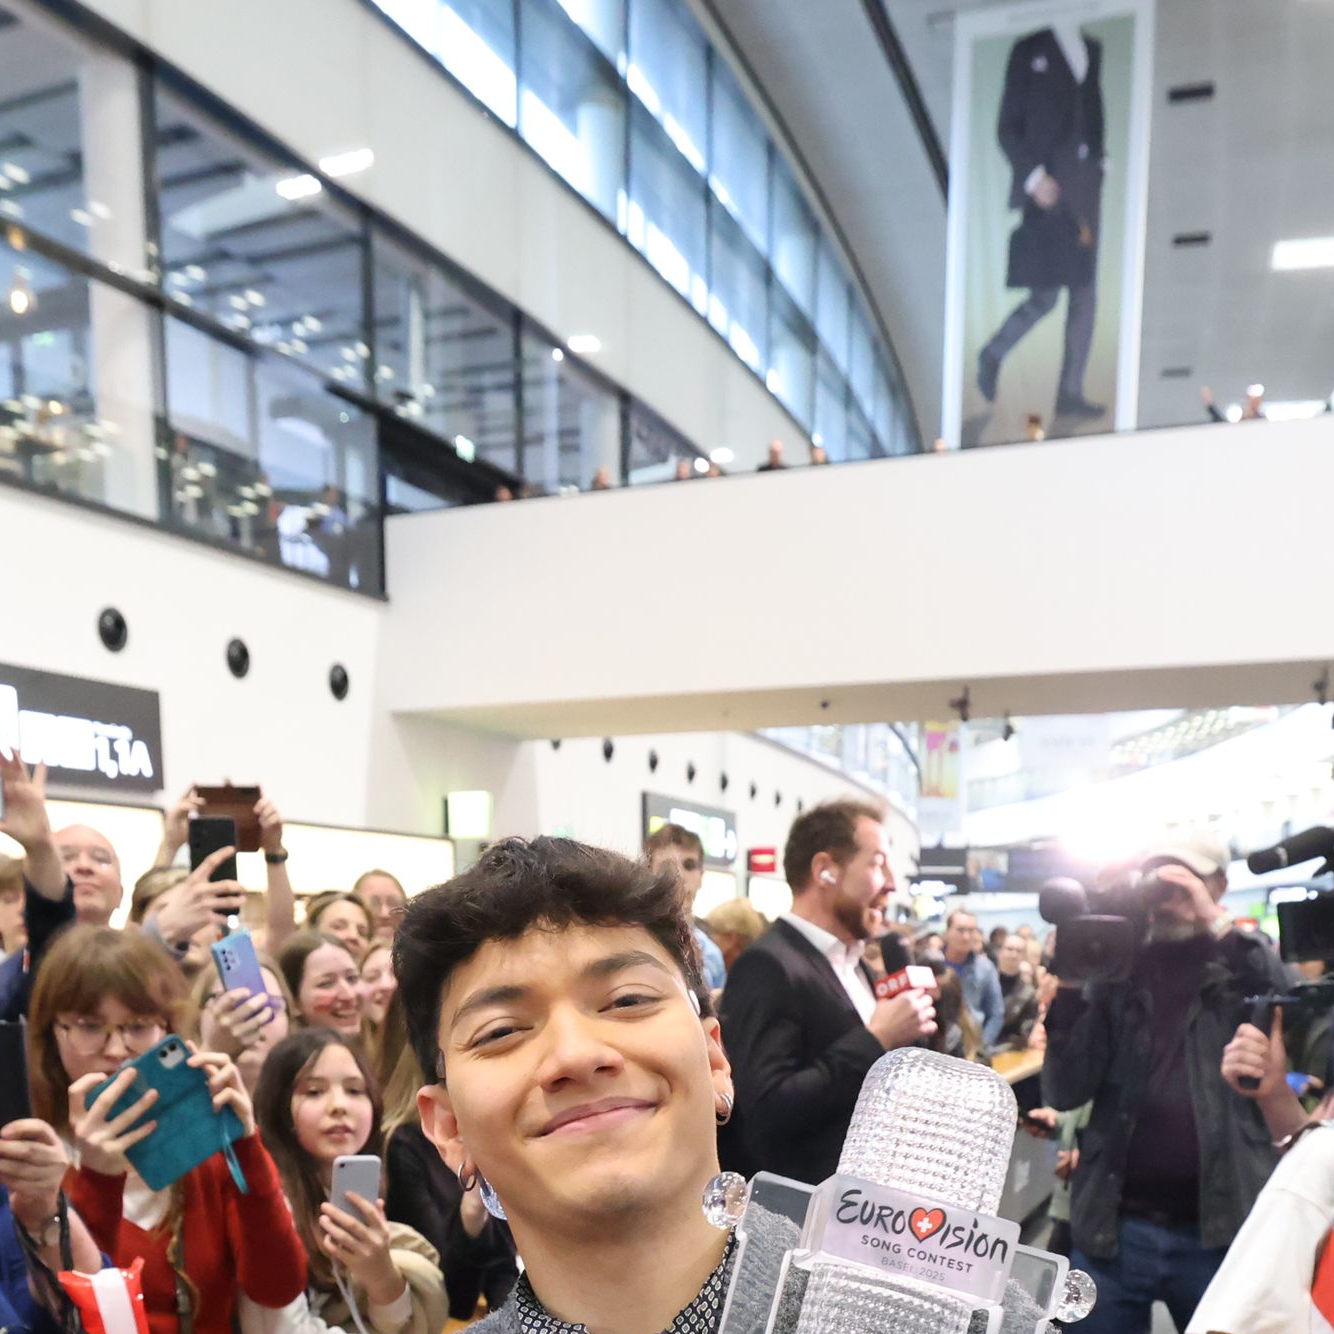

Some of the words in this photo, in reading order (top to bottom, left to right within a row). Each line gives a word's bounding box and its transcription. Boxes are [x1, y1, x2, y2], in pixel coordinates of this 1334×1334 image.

[861, 1234, 902, 1254] SONG
[907, 1247, 974, 1274] CONTEST
[918, 1268, 947, 1282] 2025
